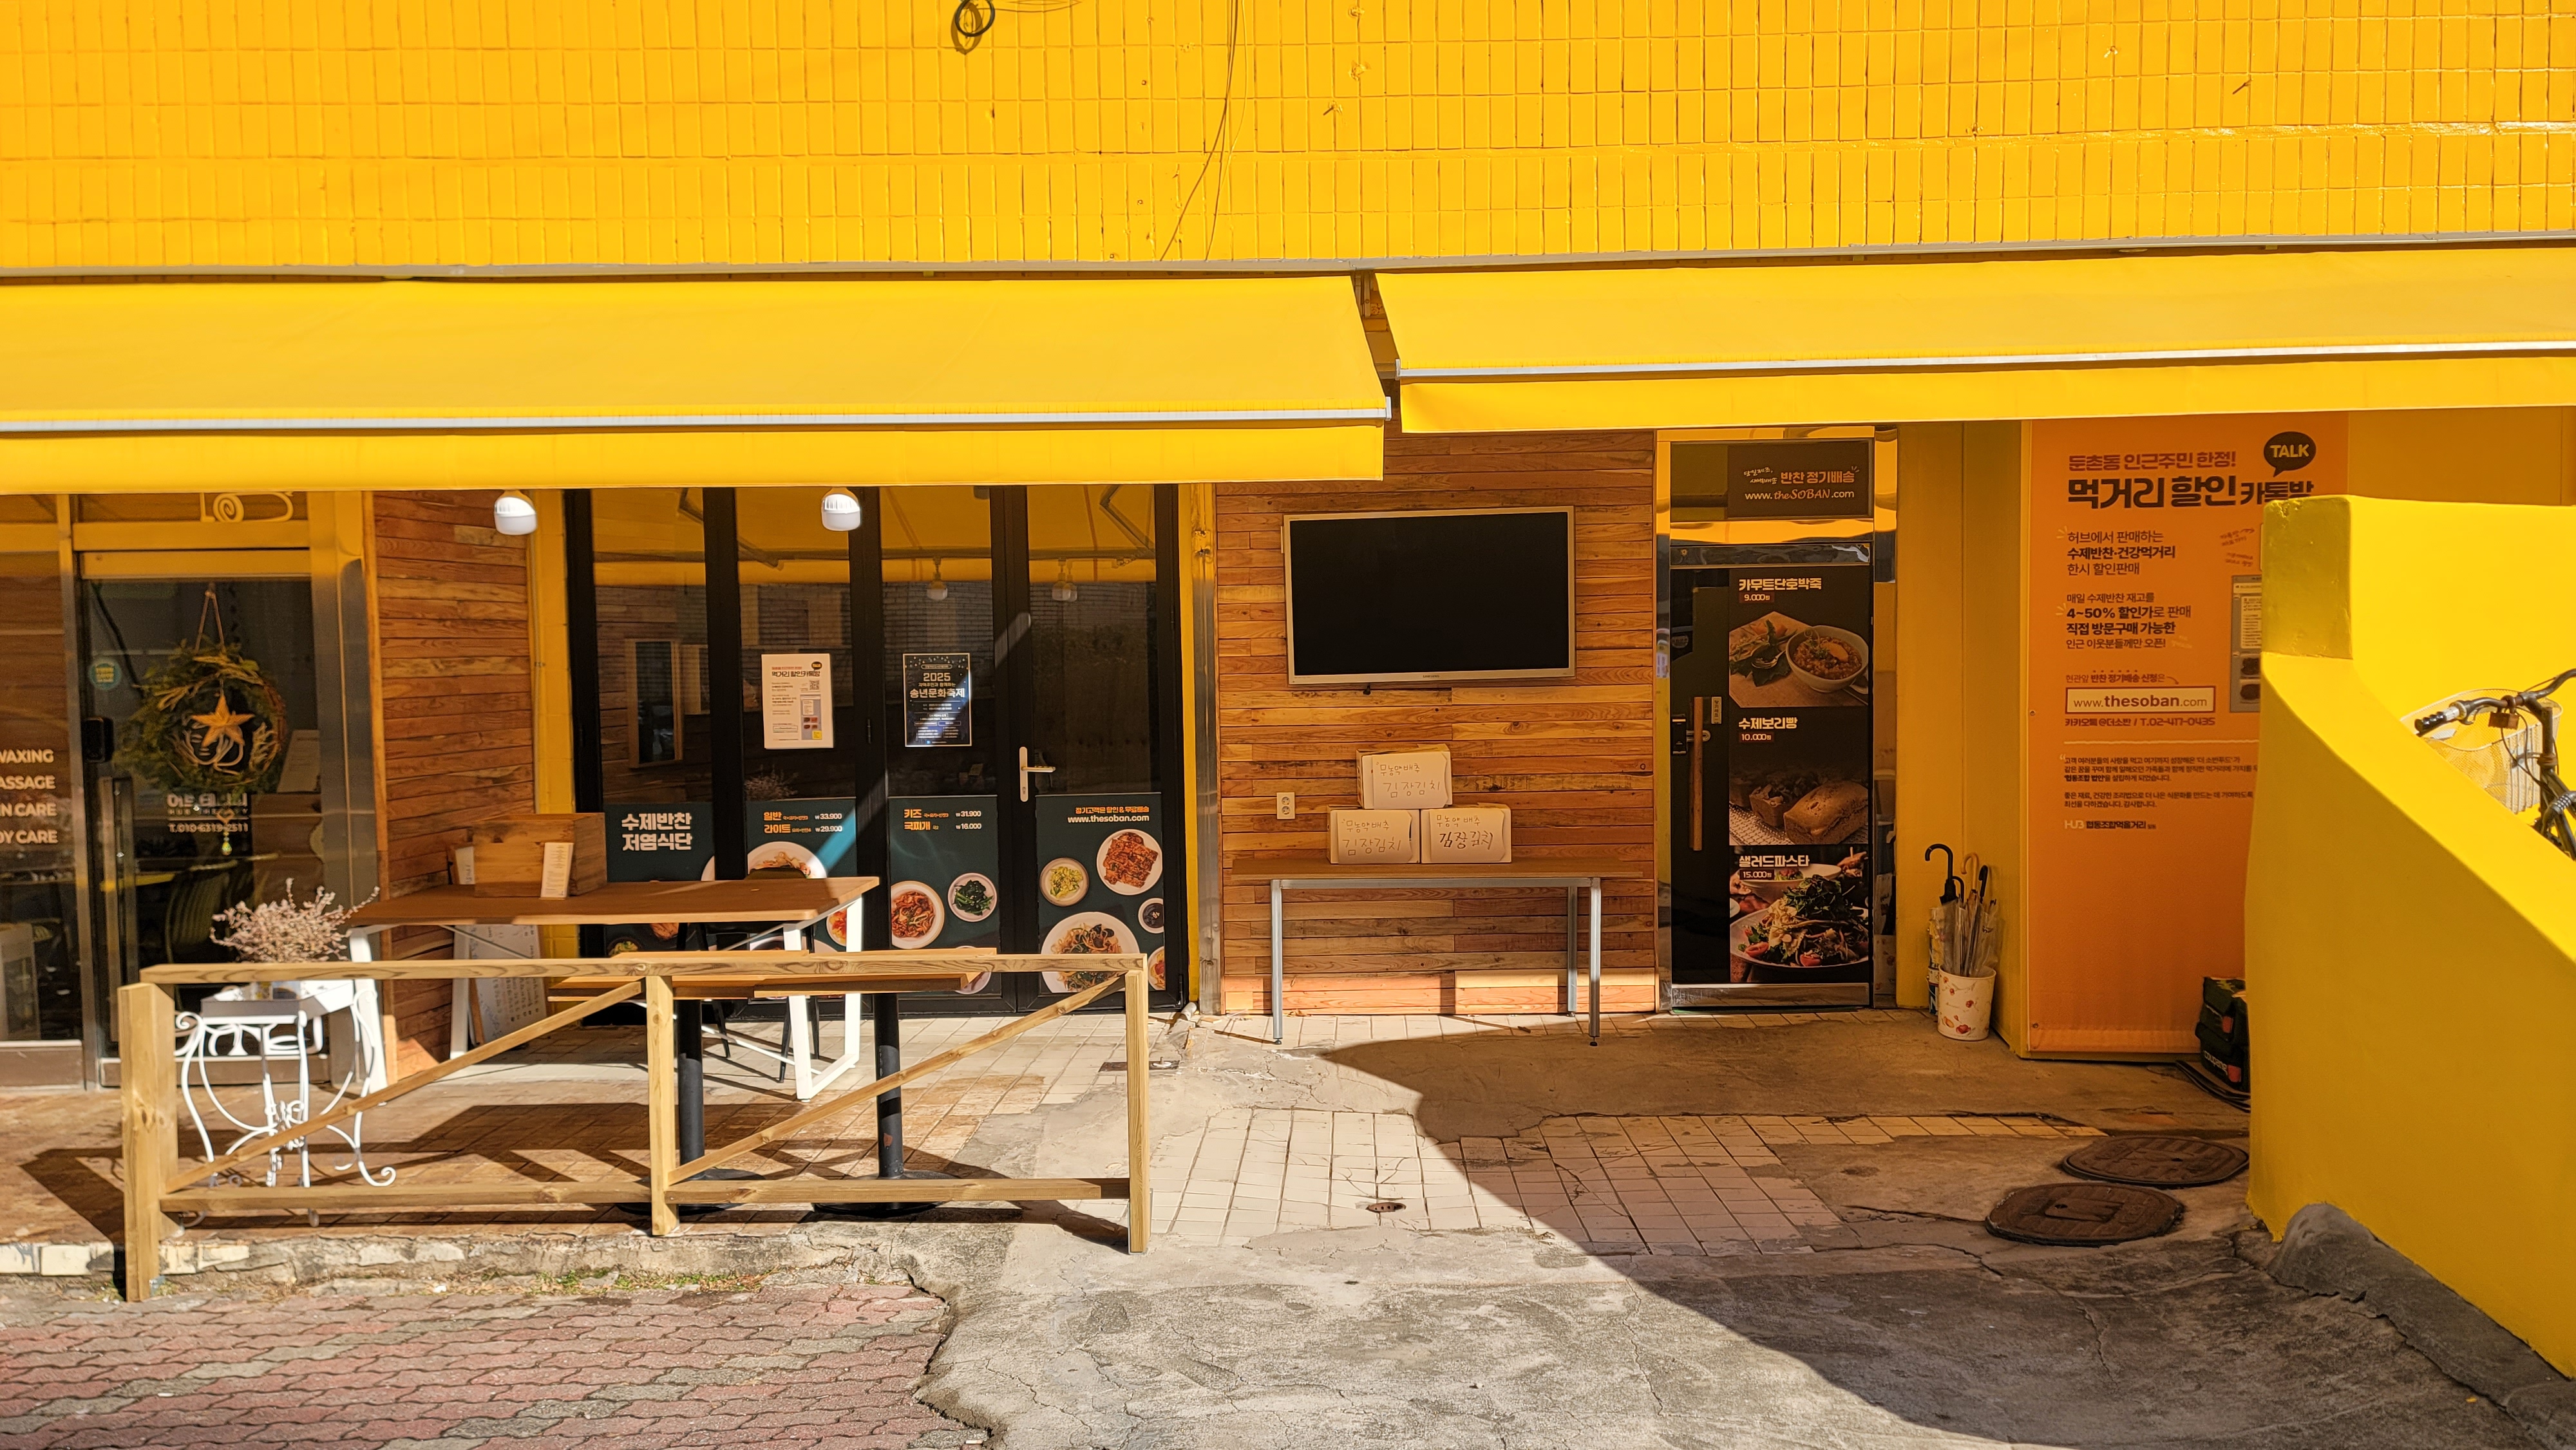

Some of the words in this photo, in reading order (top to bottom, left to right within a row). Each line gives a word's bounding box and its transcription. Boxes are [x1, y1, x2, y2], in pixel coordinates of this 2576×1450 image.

[2270, 444, 2310, 458] TALK
[2069, 454, 2121, 471] 둔촌동
[2124, 453, 2193, 470] 인근주민
[2197, 451, 2237, 468] 한정!
[1781, 471, 1805, 484] 반찬
[1806, 471, 1855, 484] 정기배송
[2068, 477, 2165, 509] 먹거리
[2171, 475, 2237, 507] 할인
[2240, 481, 2315, 505] 카톡방
[2067, 531, 2114, 544] 허브에서
[2117, 531, 2164, 543] 판매하는
[2067, 563, 2090, 576] 한시
[2093, 562, 2140, 576] 할인판매
[1739, 578, 1822, 591] 카무트단호박죽
[2067, 593, 2085, 604] 매일
[2087, 593, 2125, 604] 수제반찬
[2126, 592, 2154, 603] 재고를
[2067, 607, 2116, 619] 4~50%
[2118, 606, 2165, 619] 할인가로
[2168, 605, 2191, 619] 판매
[2067, 623, 2090, 636] 직접
[2092, 622, 2138, 636] 방문구매
[2141, 621, 2176, 635] 가능한
[2066, 639, 2085, 650] 인근
[2144, 638, 2166, 649] 오픈!
[923, 672, 951, 682] 2025
[909, 688, 965, 699] 송년문화축제
[2073, 695, 2208, 708] www.thesoban.com
[1738, 717, 1799, 730] 수제보리빵
[2140, 717, 2216, 726] T.02-417-0435
[14, 802, 57, 817] CARE
[763, 811, 782, 821] 일반
[904, 809, 922, 818] 키즈
[621, 812, 692, 831] 수제반찬
[1068, 814, 1150, 823] www.thesoban.com
[764, 824, 791, 834] 라이트
[15, 829, 59, 844] CARE
[622, 833, 693, 851] 저염식단
[1739, 855, 1810, 867] 샐러드파스타
